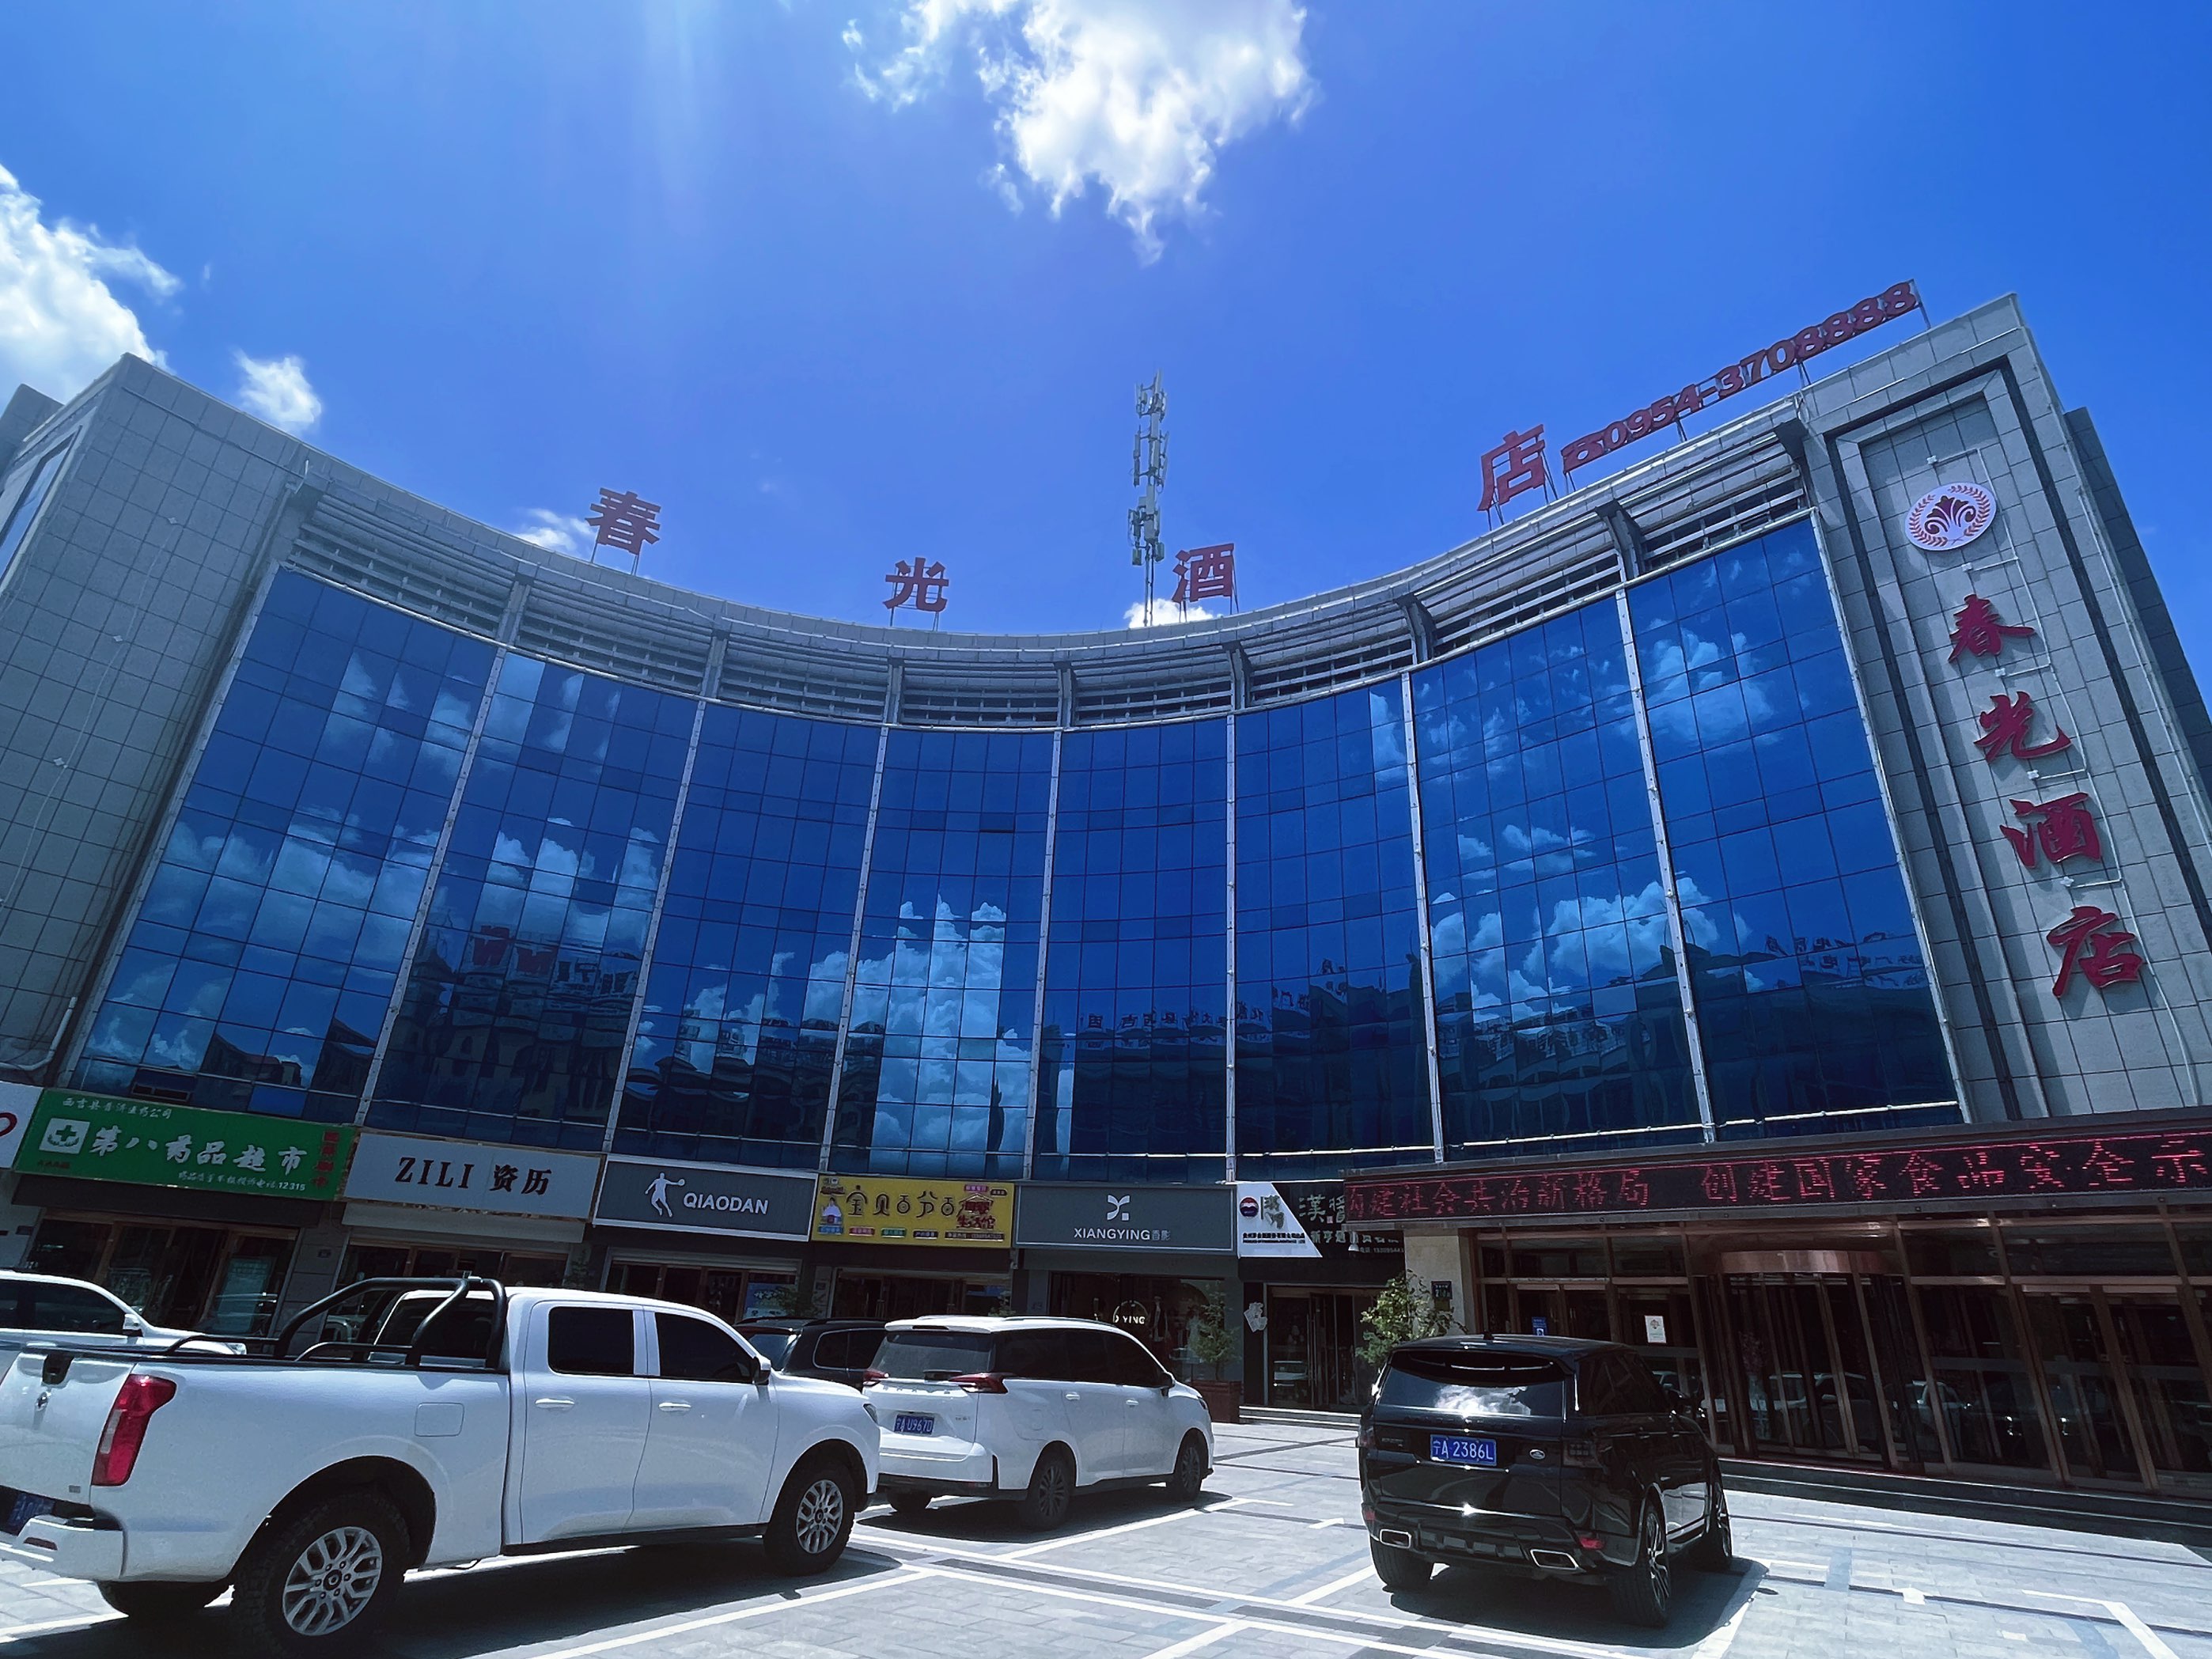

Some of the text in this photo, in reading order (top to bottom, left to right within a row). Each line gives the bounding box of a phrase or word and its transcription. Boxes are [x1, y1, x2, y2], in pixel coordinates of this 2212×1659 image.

[1948, 593, 2144, 999] 春光酒店
[394, 1156, 553, 1195] ZILI 资历
[683, 1191, 770, 1215] QIAODAN
[1073, 1227, 1150, 1240] XIANGYING
